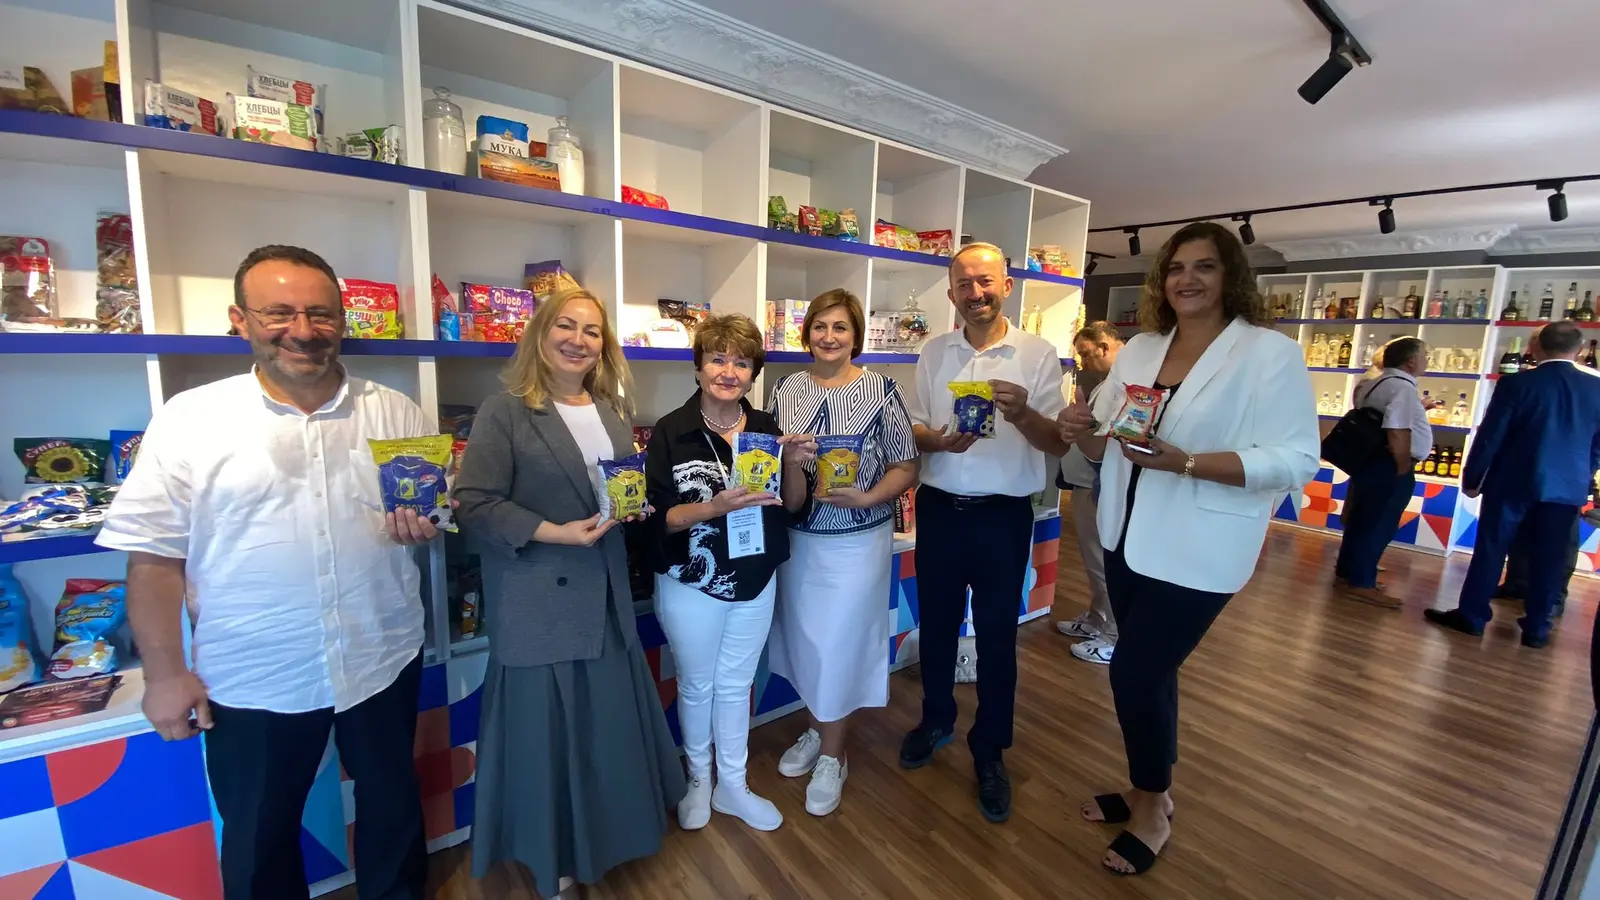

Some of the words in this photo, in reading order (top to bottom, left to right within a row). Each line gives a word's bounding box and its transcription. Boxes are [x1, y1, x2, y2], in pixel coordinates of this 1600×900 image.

[258, 75, 289, 89] ХЛЕБЦЫ
[167, 92, 194, 109] ХЛЕБЦЫ
[246, 103, 281, 115] ХЛЕБЦЫ
[490, 142, 523, 157] МУКА
[494, 291, 522, 306] Choco
